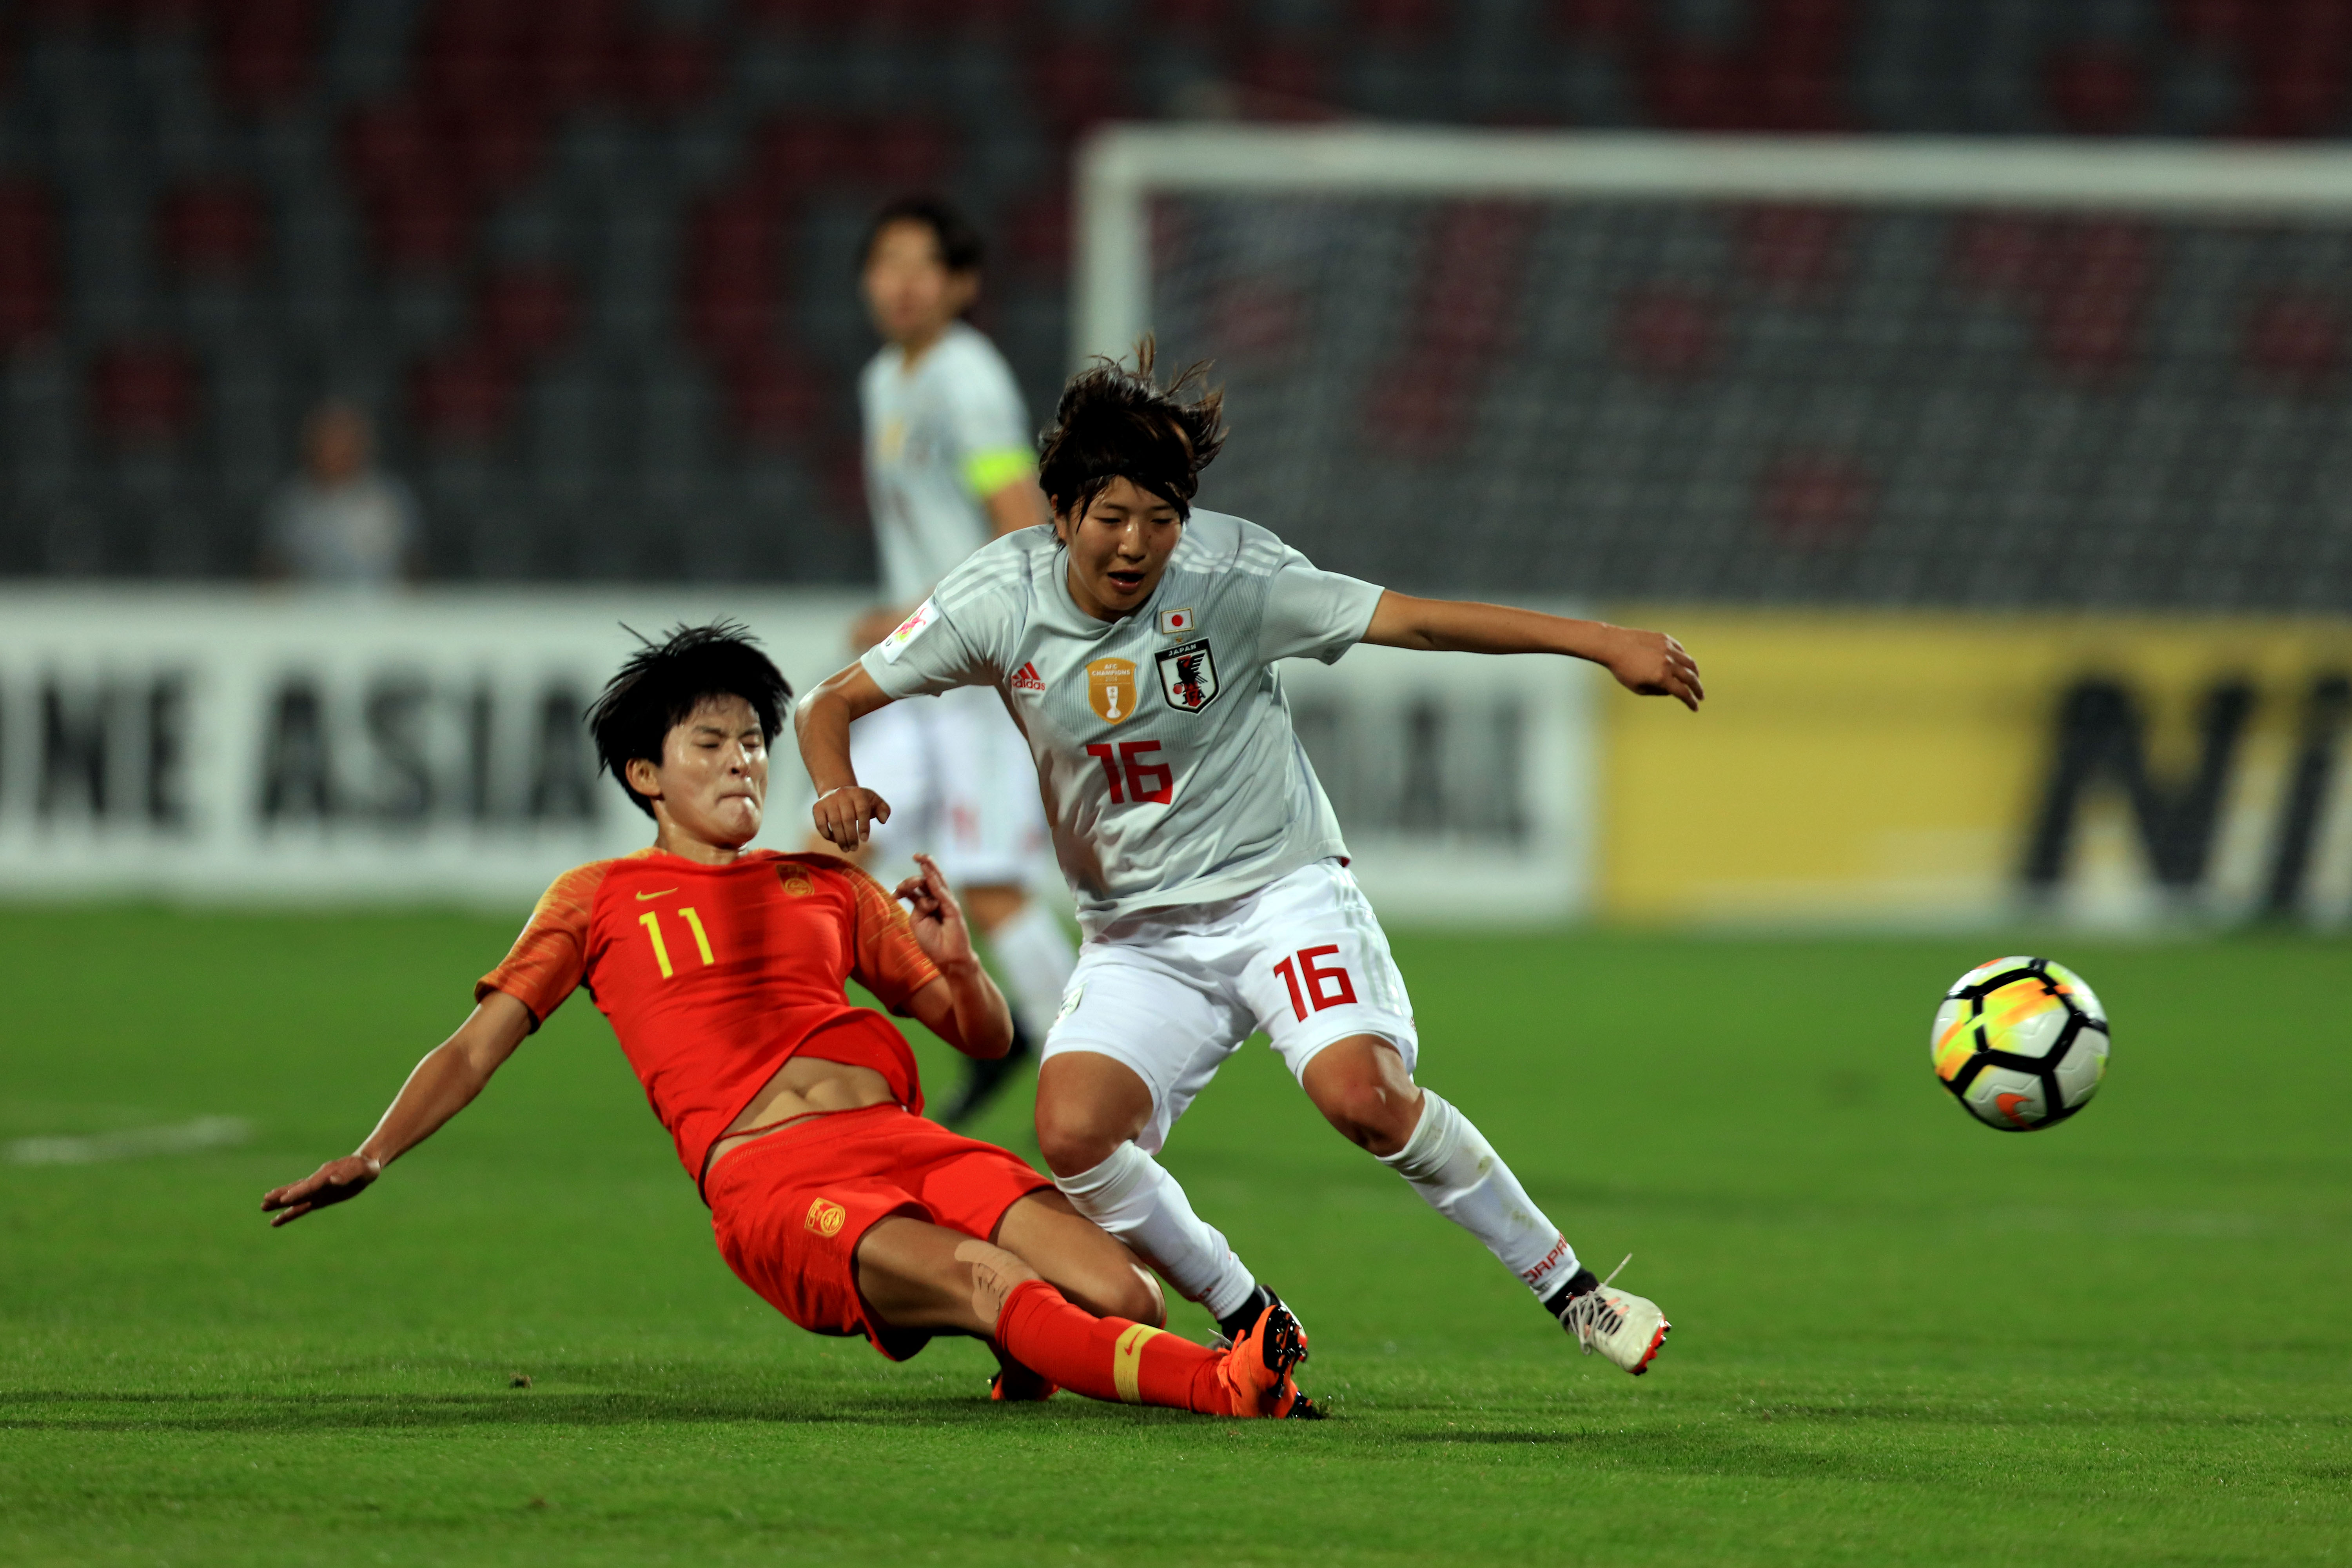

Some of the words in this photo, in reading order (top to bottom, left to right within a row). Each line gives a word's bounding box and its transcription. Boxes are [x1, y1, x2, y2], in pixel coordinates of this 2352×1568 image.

[1168, 644, 1197, 657] JAPAN
[1182, 688, 1207, 705] JFA
[0, 662, 196, 829] NE
[253, 662, 602, 829] ASIA
[1087, 740, 1173, 804] 16
[639, 907, 715, 979] 11
[1274, 944, 1358, 1023] 16
